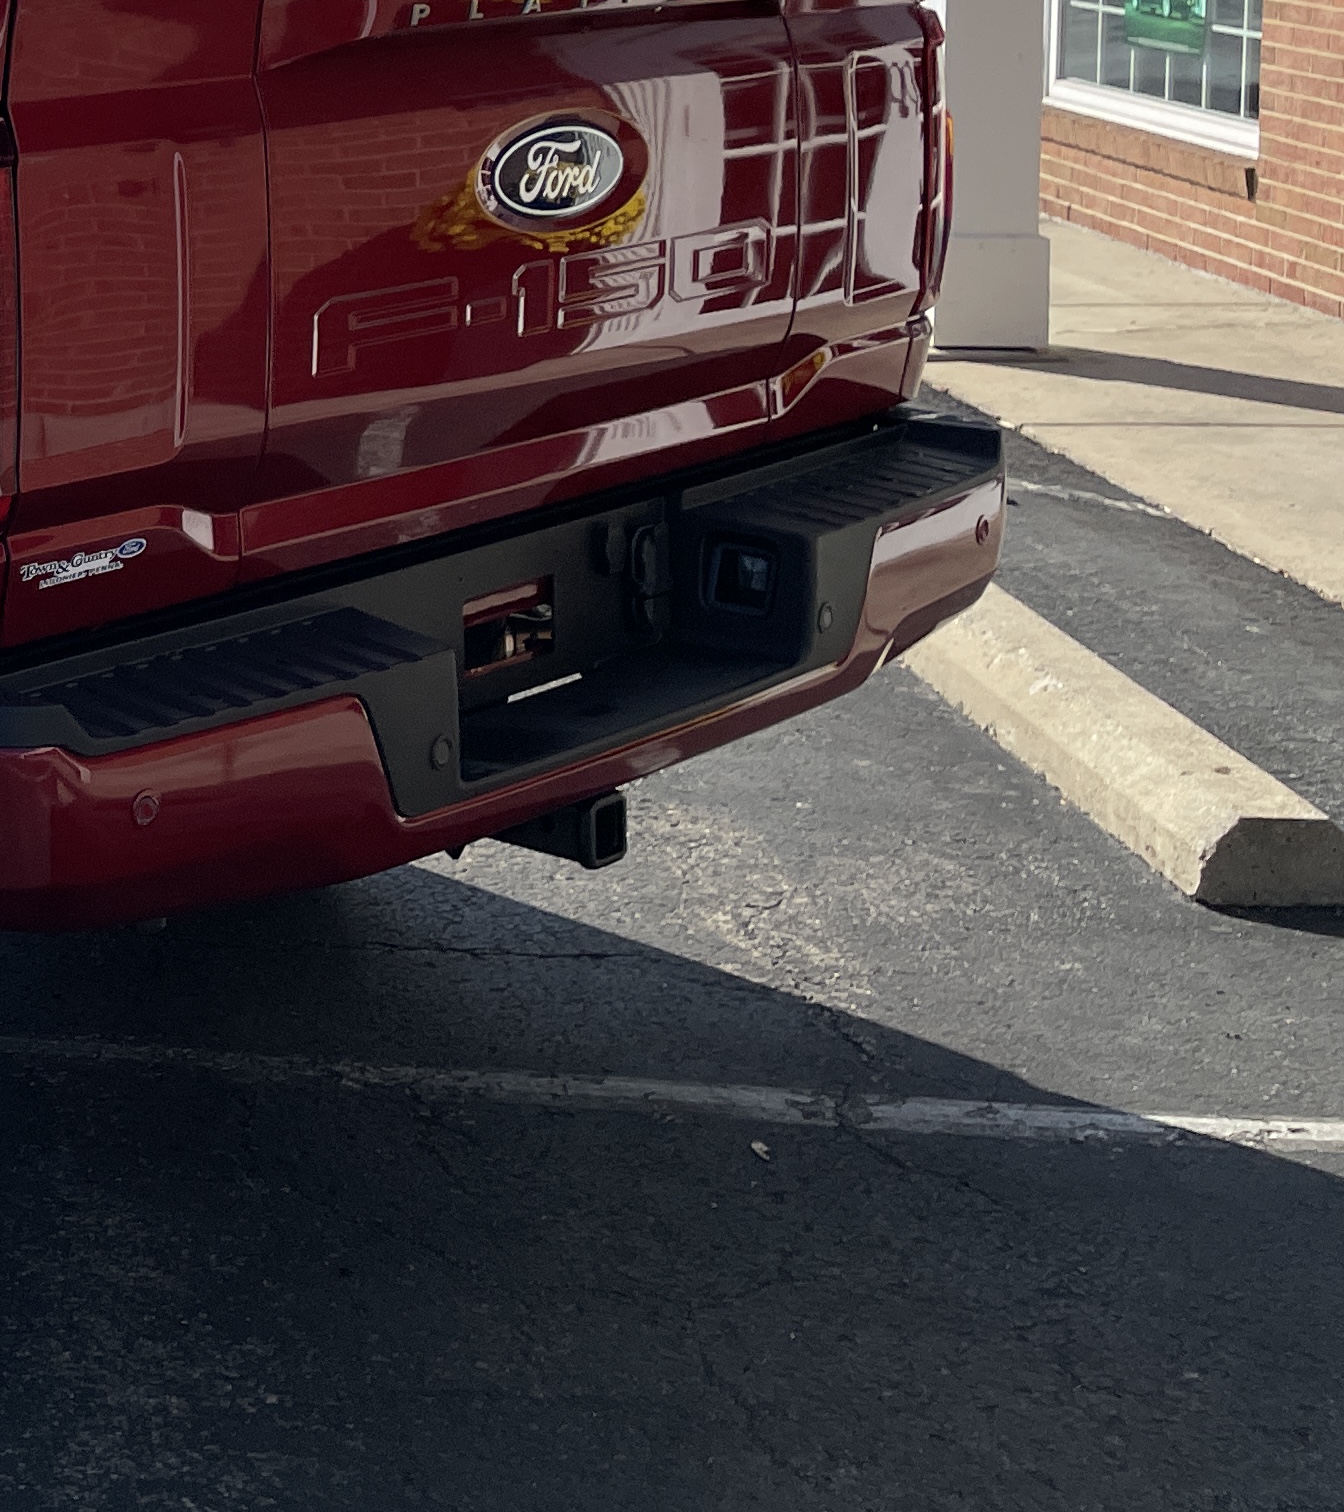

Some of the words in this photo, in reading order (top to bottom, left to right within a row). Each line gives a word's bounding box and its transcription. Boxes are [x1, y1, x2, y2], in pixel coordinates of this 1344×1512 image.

[519, 139, 601, 202] Ford
[311, 218, 773, 378] F-150
[20, 561, 57, 579] Town
